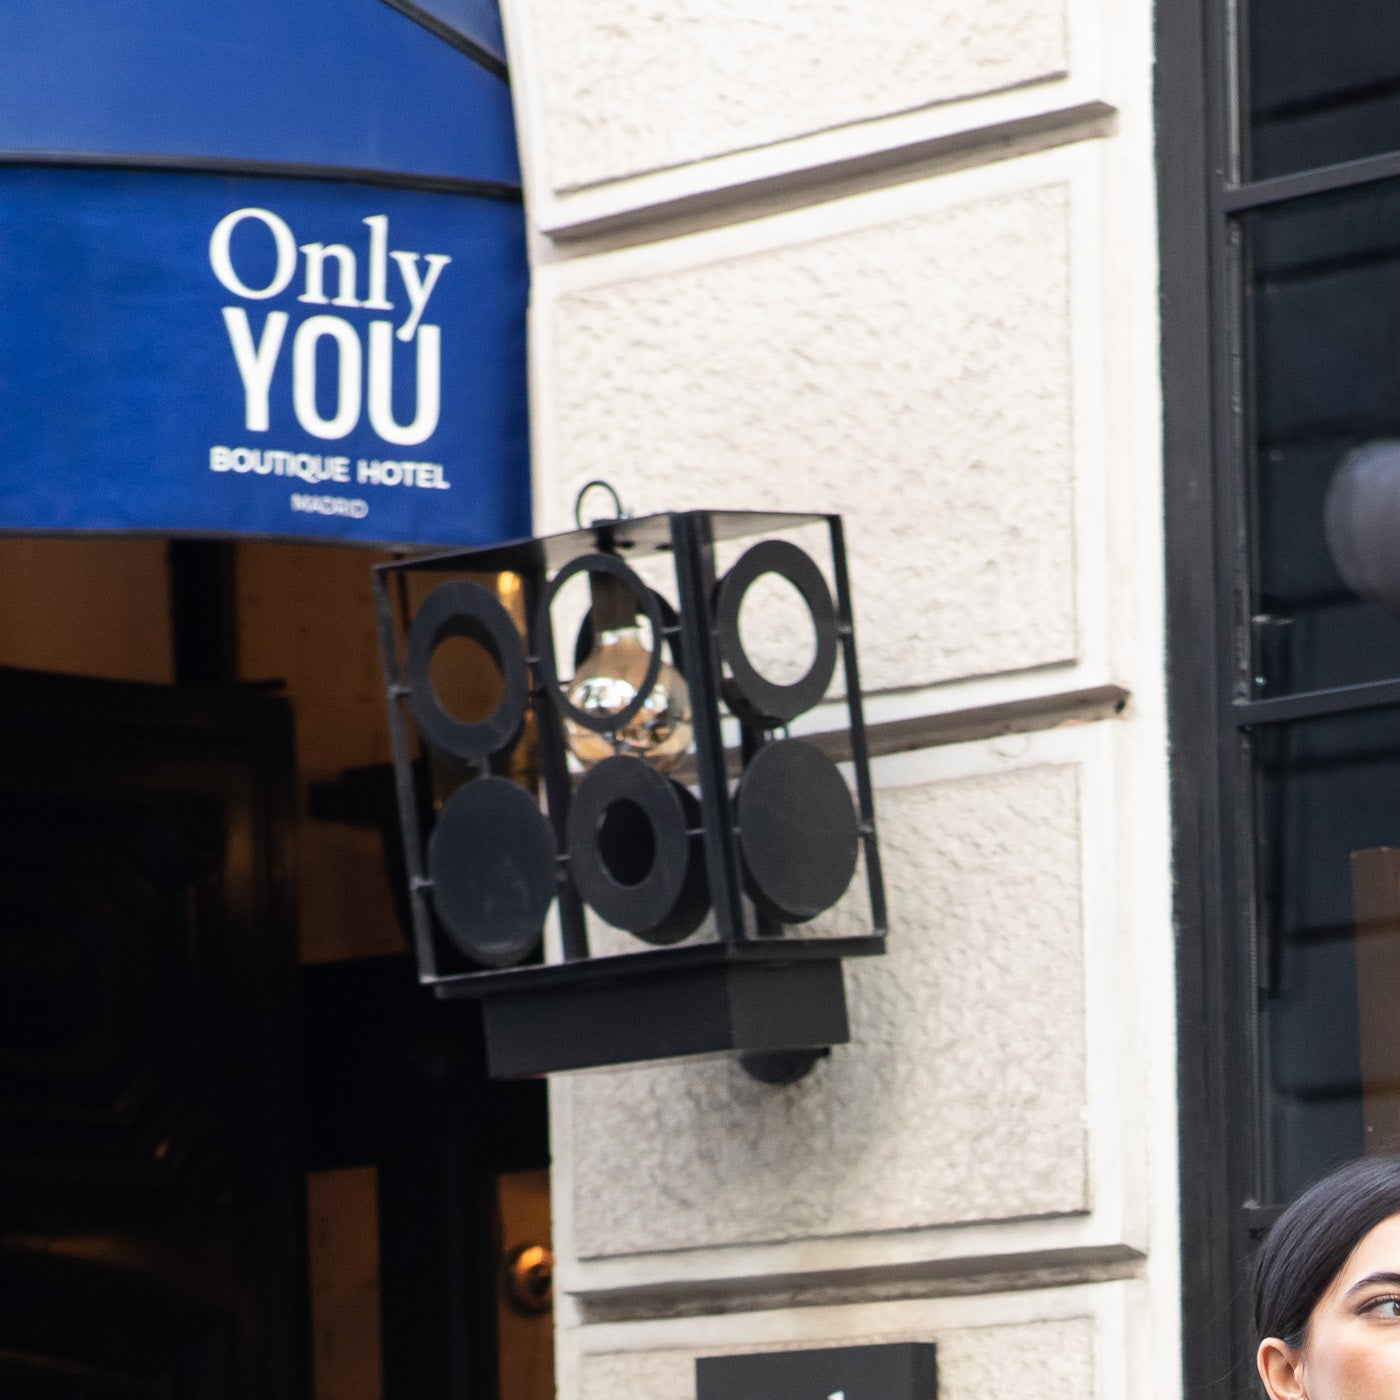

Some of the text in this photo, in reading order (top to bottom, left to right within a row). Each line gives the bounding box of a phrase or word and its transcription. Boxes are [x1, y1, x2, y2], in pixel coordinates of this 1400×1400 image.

[209, 207, 452, 342] Only
[221, 306, 441, 446] YOU
[209, 446, 452, 490] BOUTIQUE HOTEL
[290, 493, 369, 519] MADRID
